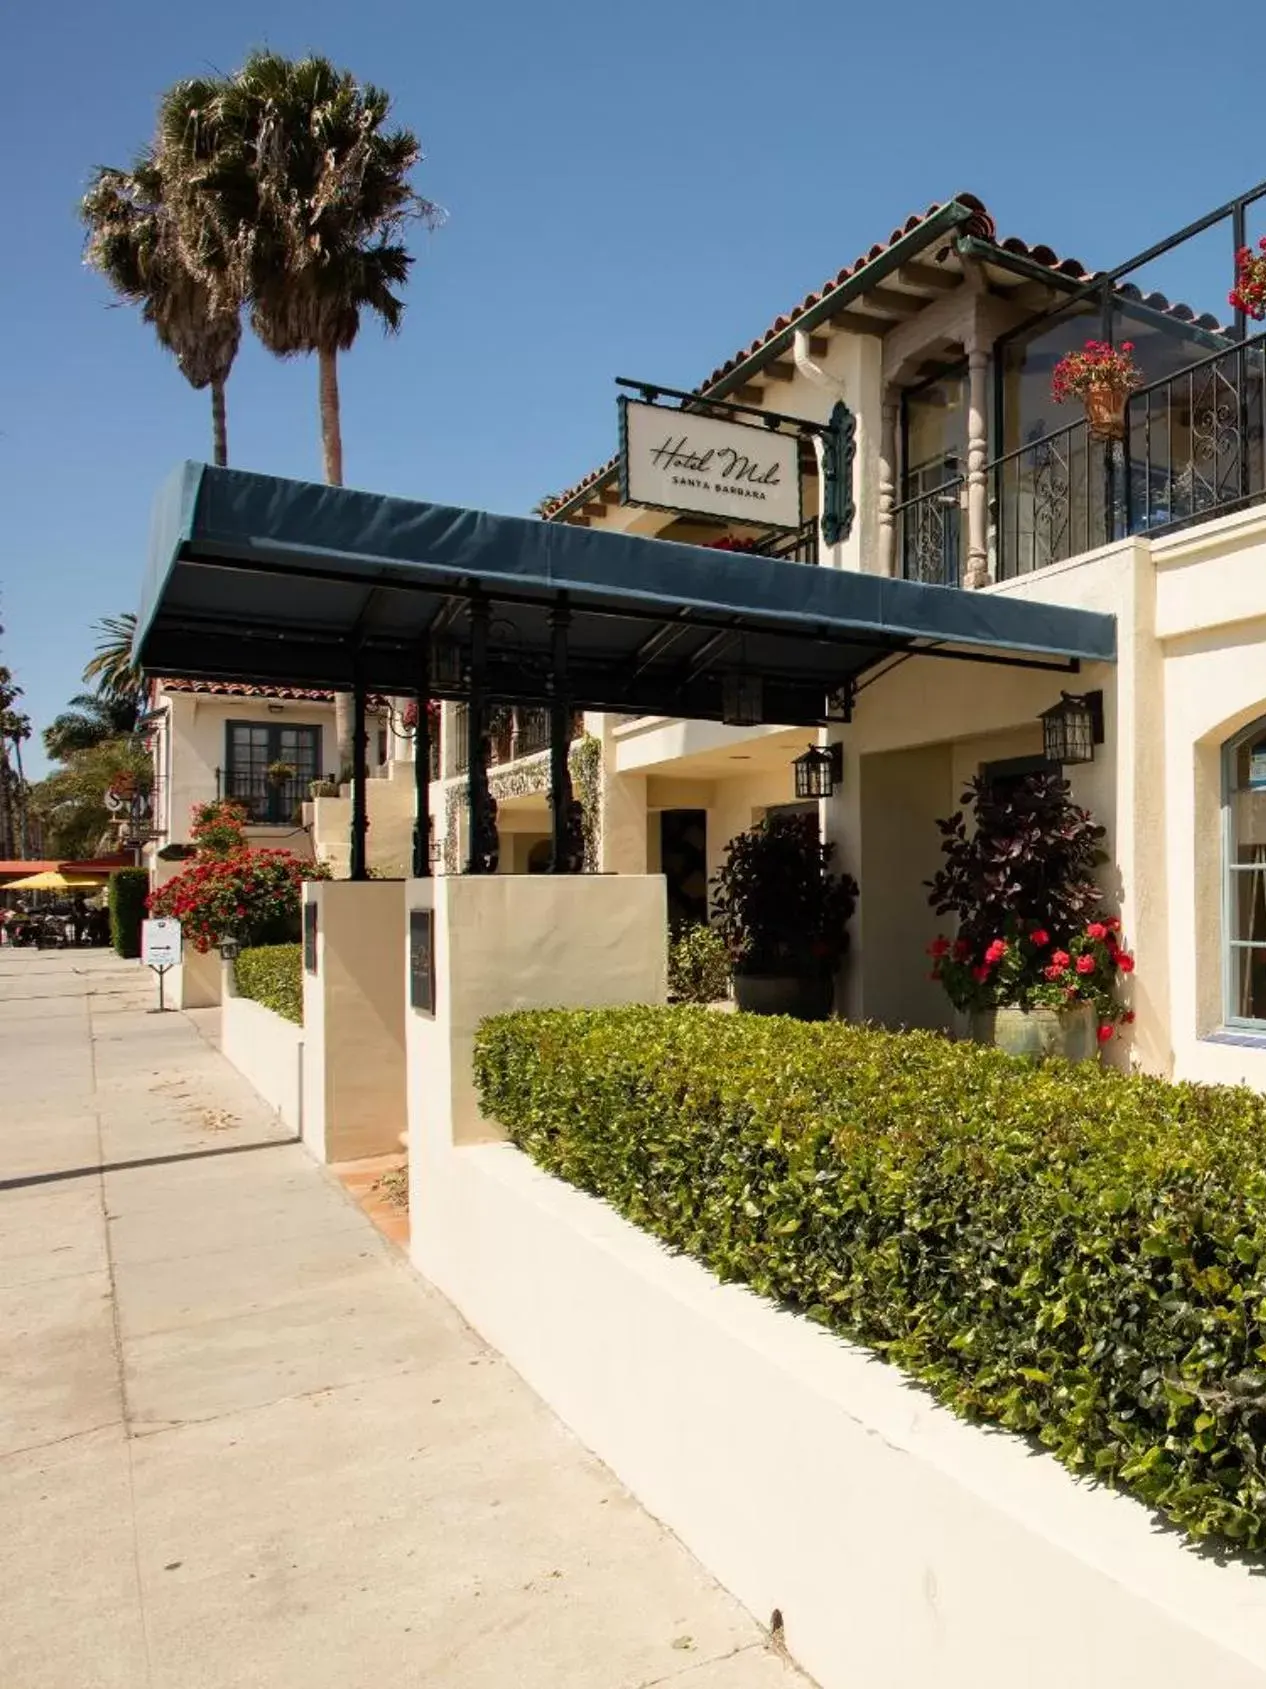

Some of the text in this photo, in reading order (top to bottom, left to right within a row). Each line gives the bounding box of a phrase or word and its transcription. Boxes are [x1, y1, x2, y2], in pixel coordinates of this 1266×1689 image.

[650, 436, 780, 486] Hotel Milo
[672, 476, 766, 500] SANTA BARBARA
